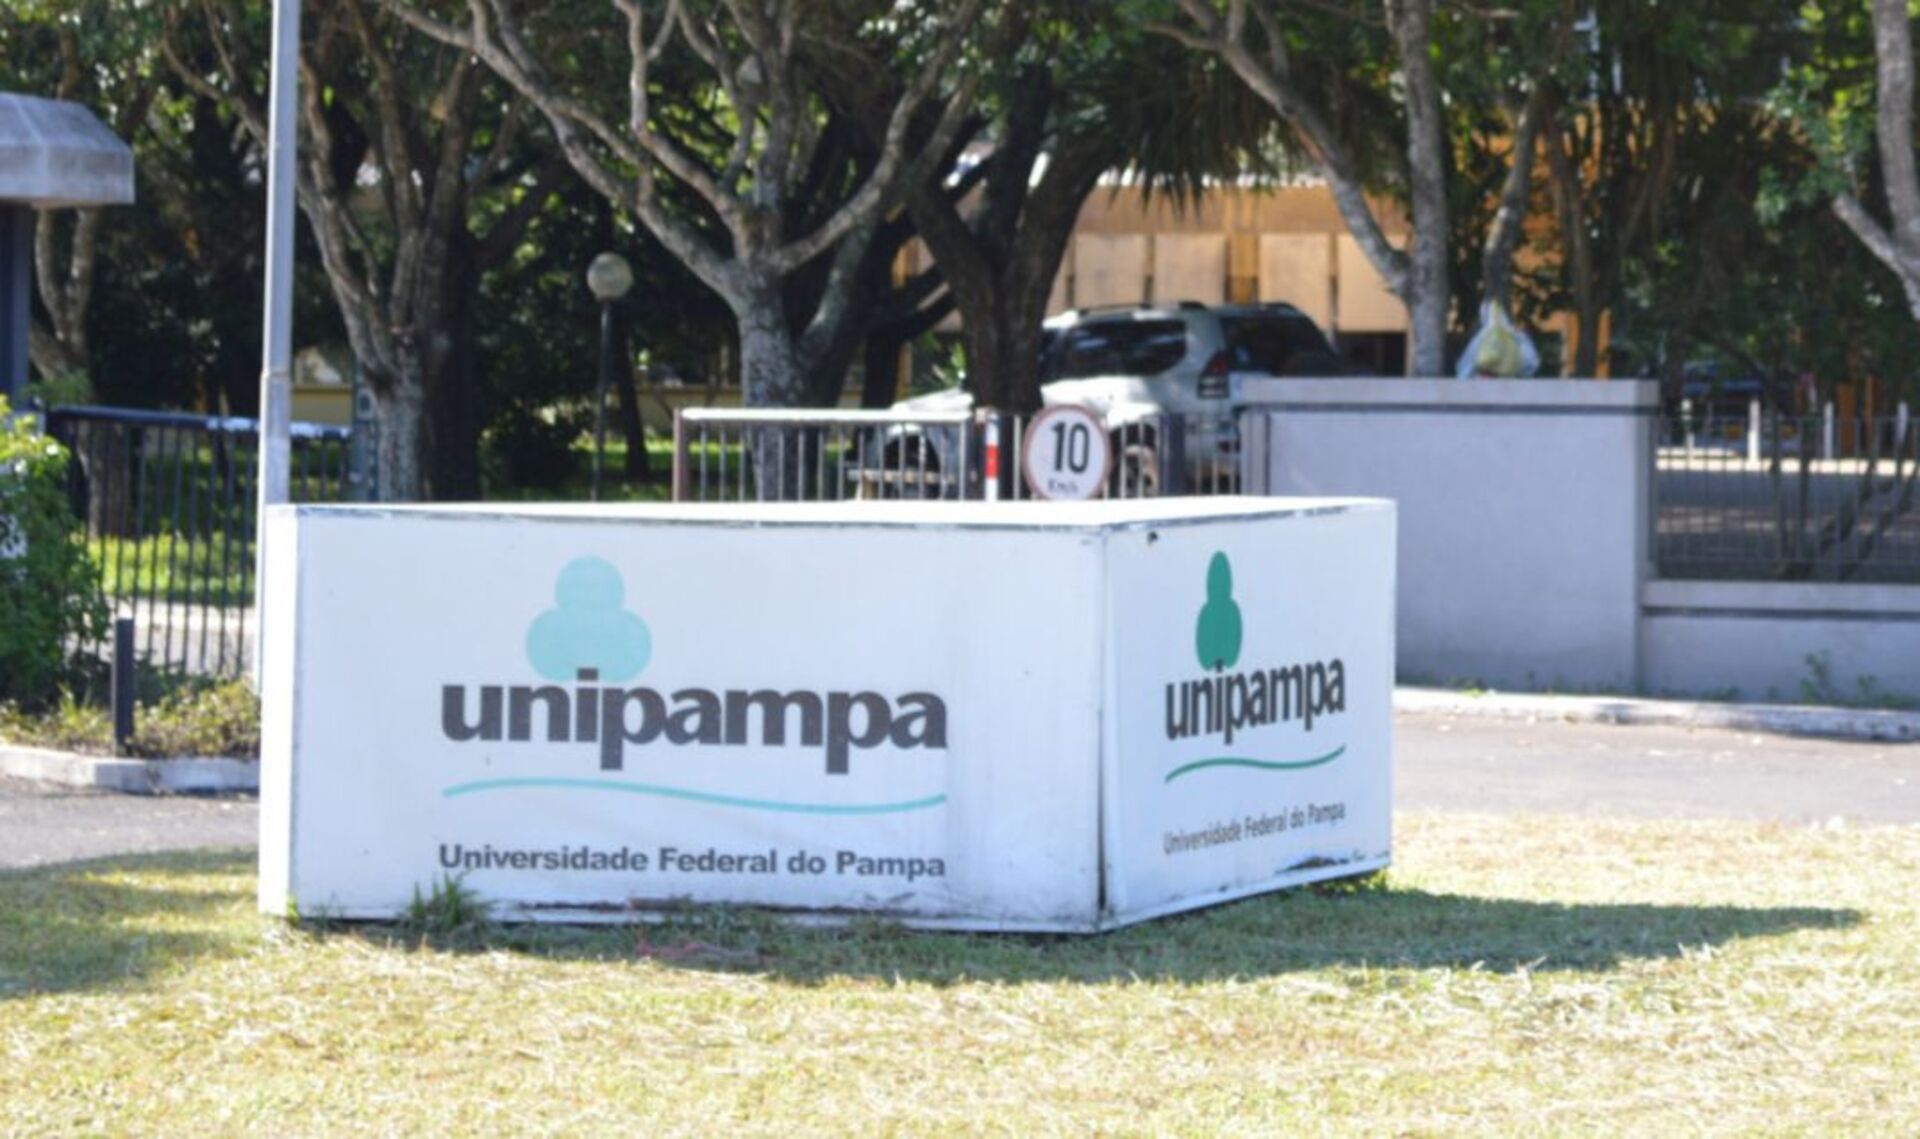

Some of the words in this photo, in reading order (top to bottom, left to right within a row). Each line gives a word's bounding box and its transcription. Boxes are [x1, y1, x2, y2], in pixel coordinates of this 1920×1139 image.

[1051, 421, 1090, 473] 10
[441, 668, 948, 774] unipampa
[1165, 657, 1346, 745] unipampa
[1163, 820, 1242, 855] Universidade
[1244, 809, 1288, 838] Federal
[1290, 805, 1305, 829] do
[1308, 802, 1346, 826] Pampa
[438, 844, 649, 872] Universidade
[658, 847, 778, 874] Federal
[786, 849, 827, 875] do
[836, 849, 946, 882] Pampa
